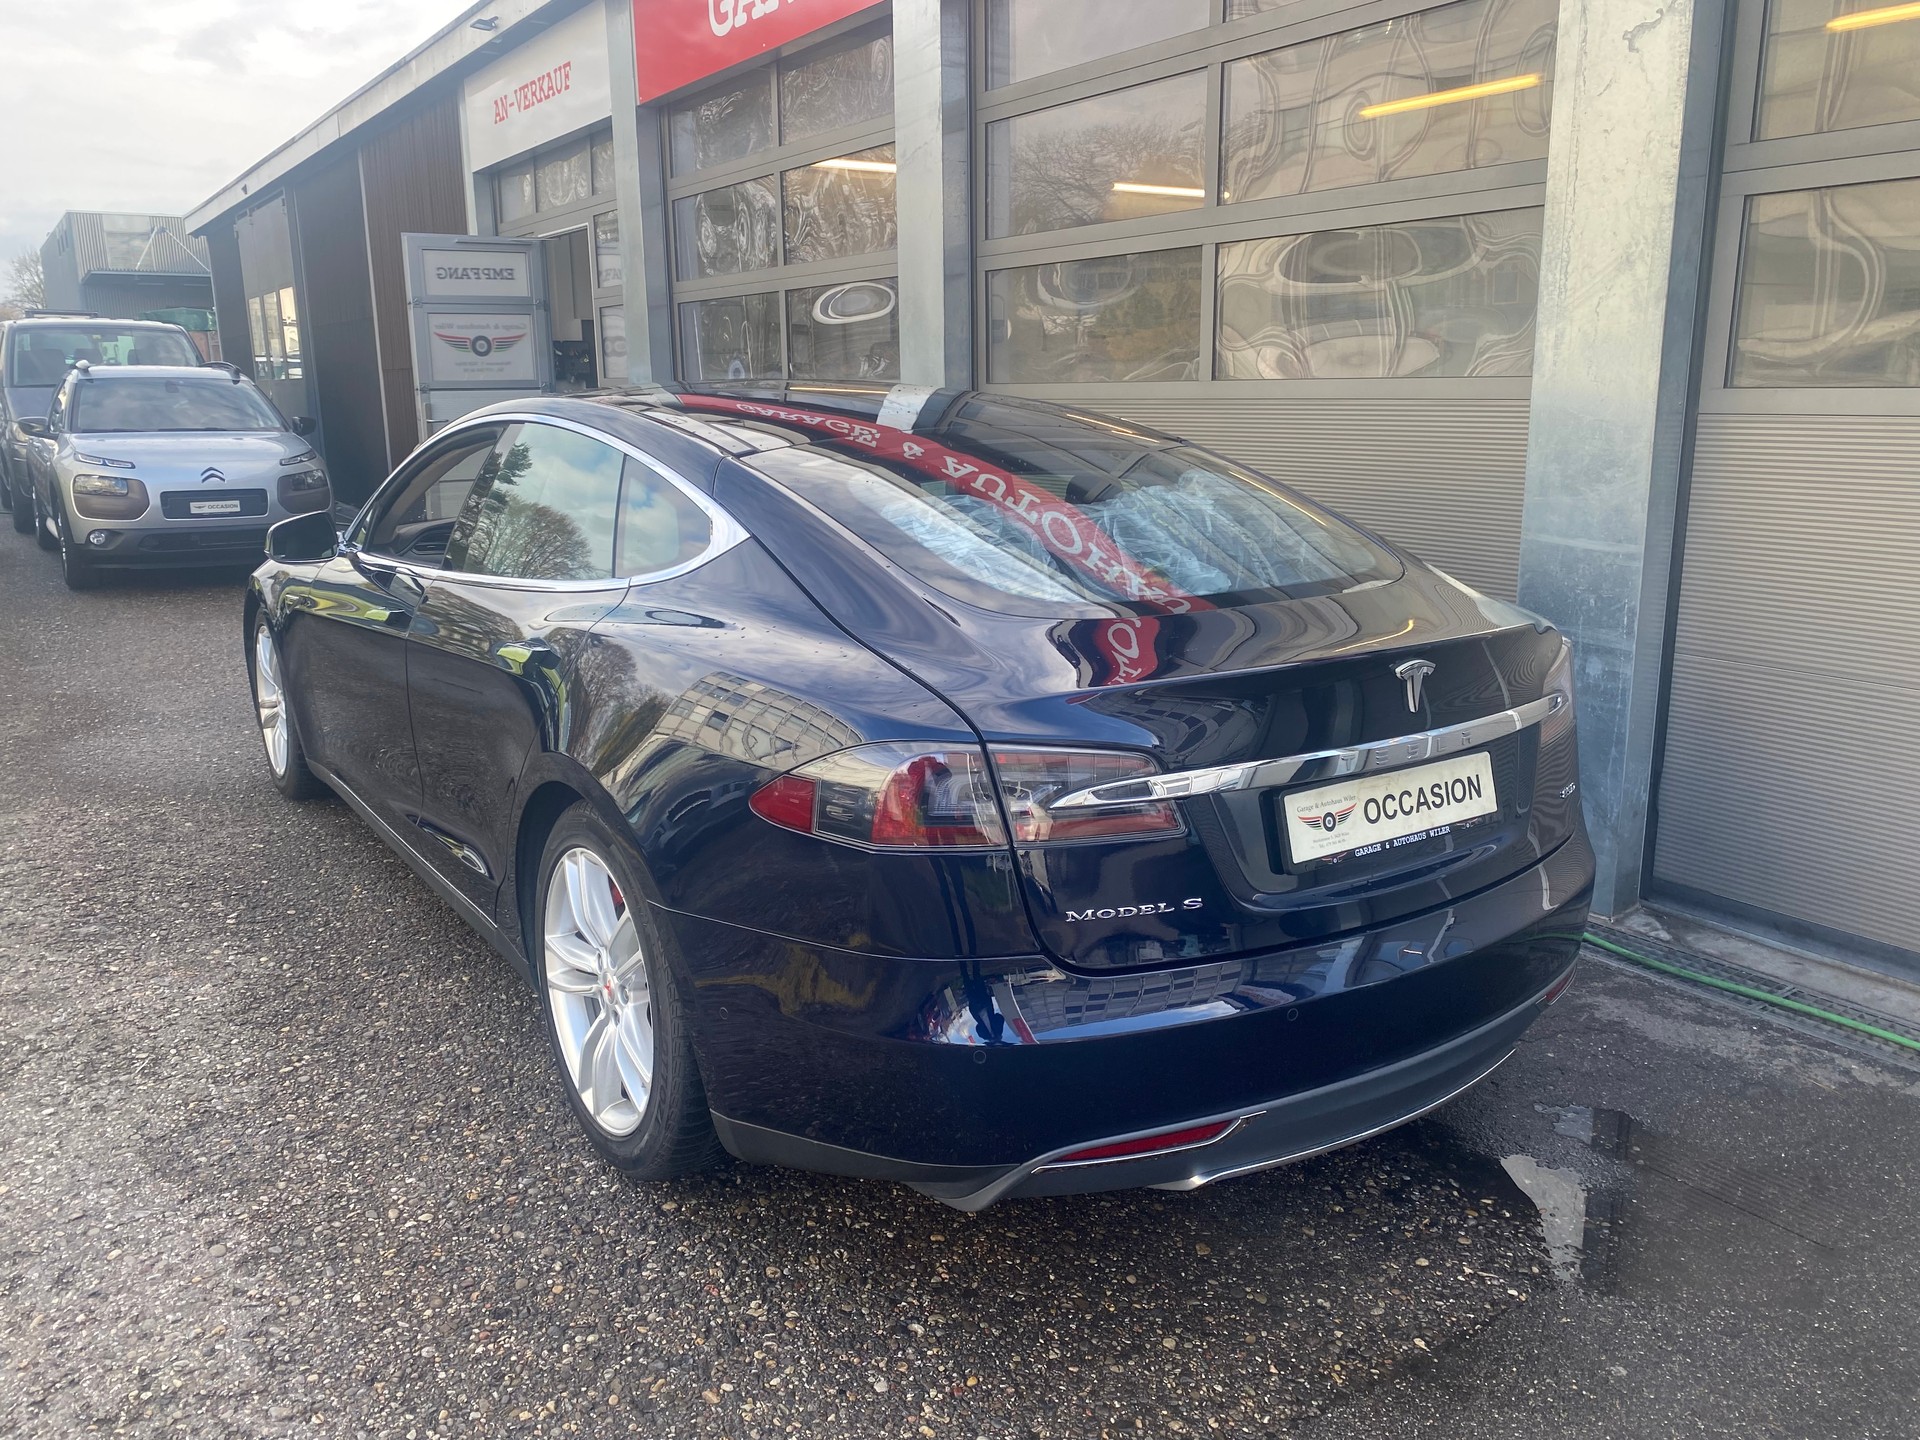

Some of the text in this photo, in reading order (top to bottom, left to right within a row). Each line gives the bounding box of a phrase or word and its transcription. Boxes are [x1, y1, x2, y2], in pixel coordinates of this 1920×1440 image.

[494, 61, 571, 124] AN-VERKAUF
[1341, 731, 1472, 771] TESLA
[1296, 804, 1314, 813] Garage
[1363, 774, 1483, 825] OCCASION
[1354, 825, 1451, 857] GARAGE & AUTOHAUS WILER
[1065, 897, 1203, 922] MODEL S
